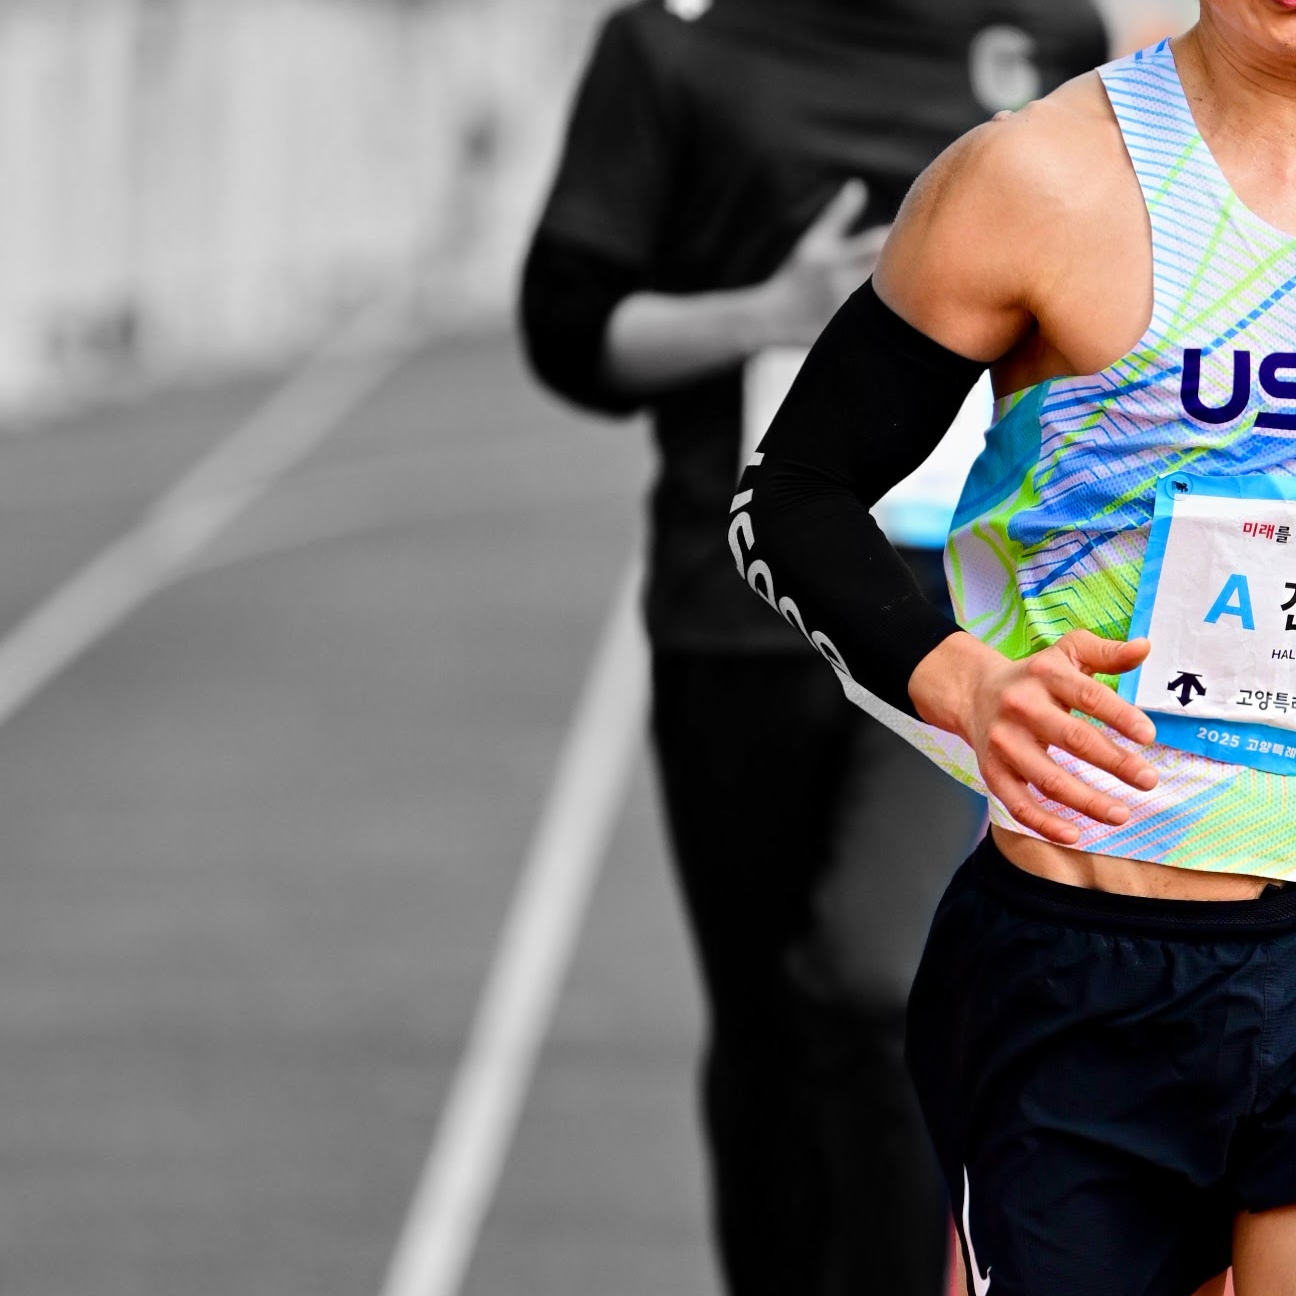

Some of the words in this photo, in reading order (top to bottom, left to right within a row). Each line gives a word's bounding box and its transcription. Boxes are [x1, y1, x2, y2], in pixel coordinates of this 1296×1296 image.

[1242, 522, 1291, 544] 미래를
[1204, 573, 1256, 631] A
[1197, 726, 1240, 748] 2025
